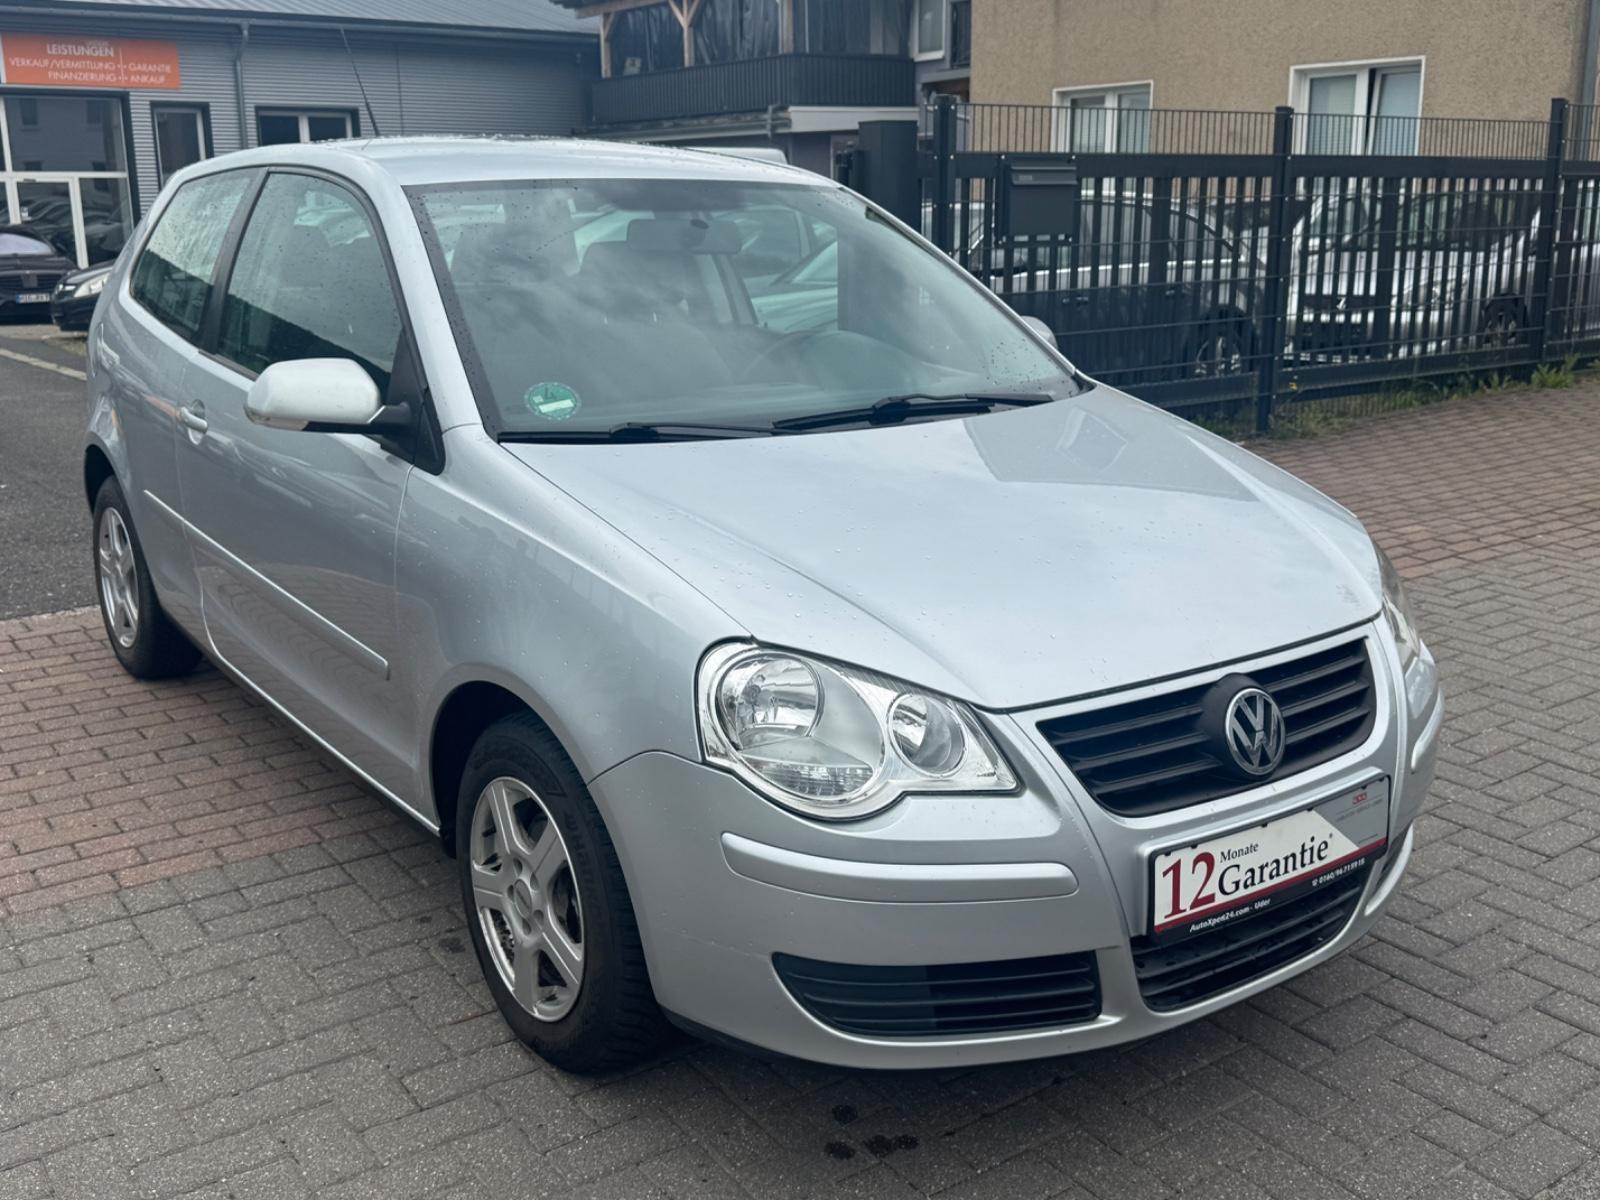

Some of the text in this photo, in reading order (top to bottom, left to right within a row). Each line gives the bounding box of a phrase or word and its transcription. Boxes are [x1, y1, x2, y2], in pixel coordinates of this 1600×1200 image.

[47, 44, 114, 57] LEISTUNGEN
[128, 62, 171, 73] GARANTIE
[48, 71, 116, 82] FINANZIERUNG
[130, 74, 165, 84] ANKAUF
[1220, 843, 1259, 863] Monate
[1162, 851, 1216, 919] 12
